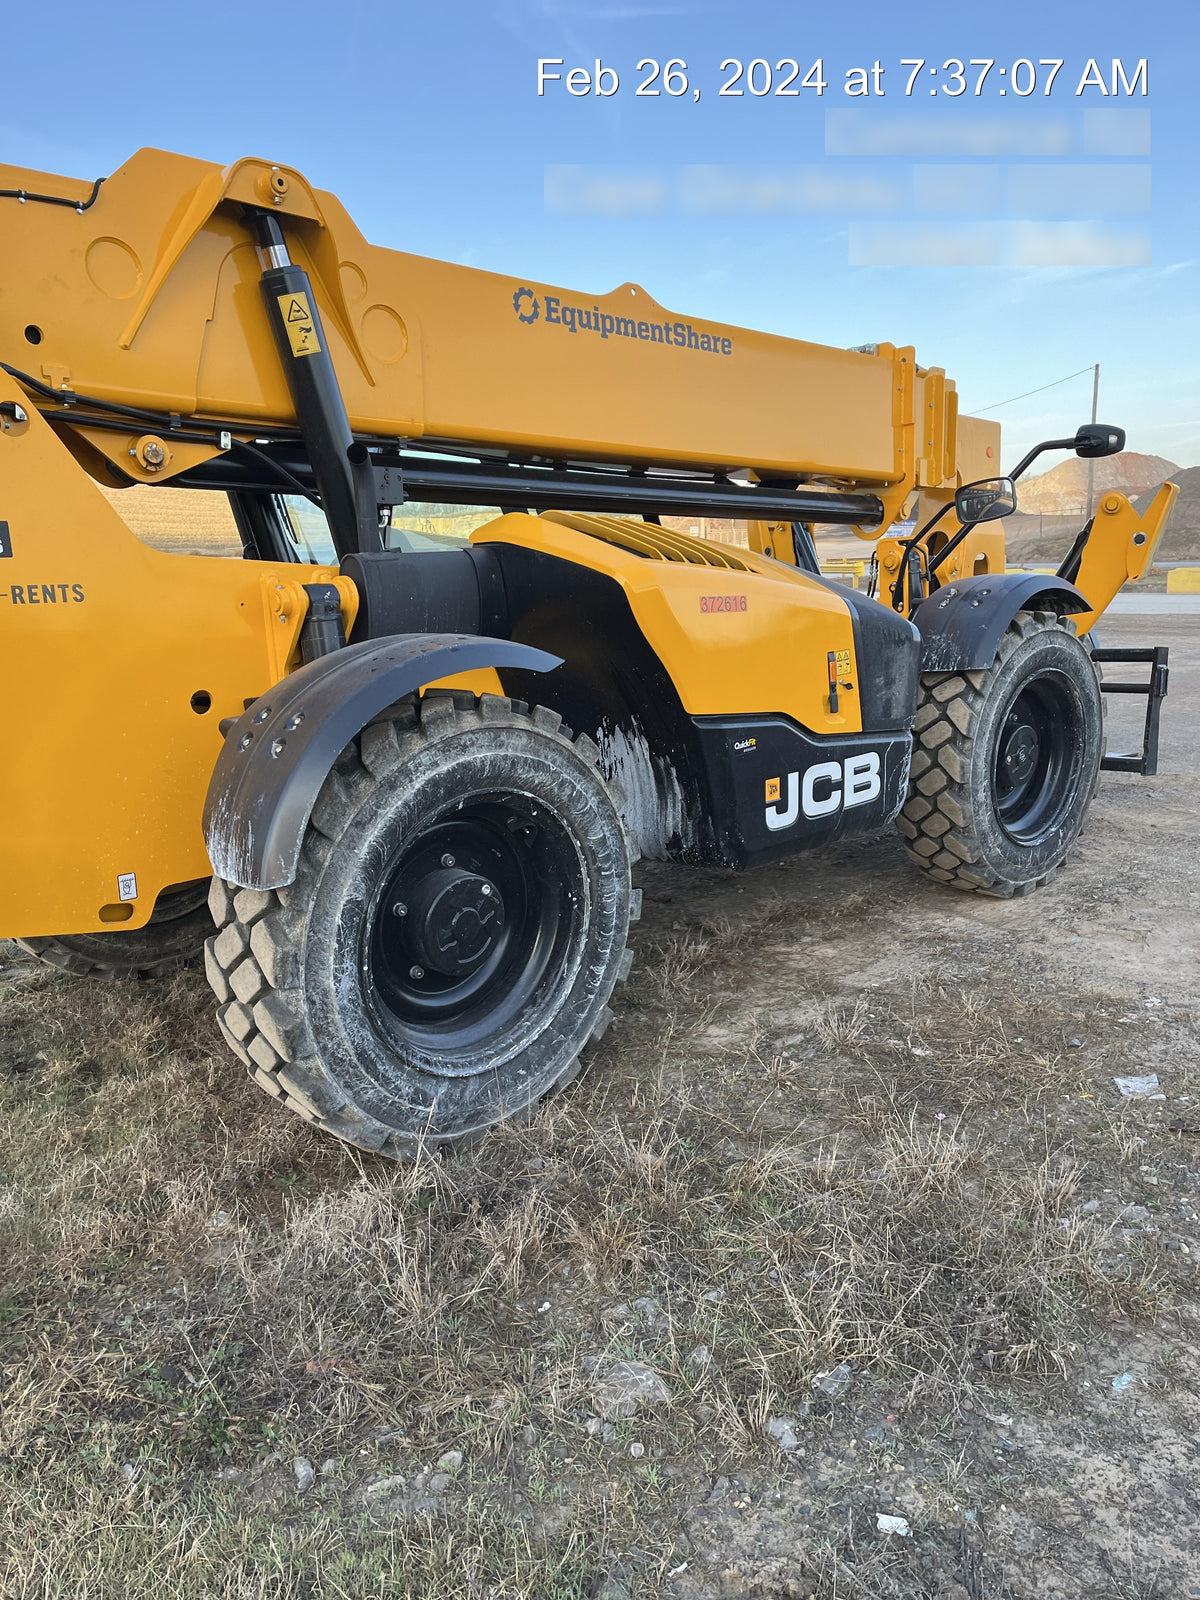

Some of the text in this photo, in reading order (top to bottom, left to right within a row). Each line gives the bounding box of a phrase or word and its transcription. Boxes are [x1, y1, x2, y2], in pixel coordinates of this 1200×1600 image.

[544, 296, 732, 355] EquipmentShare
[700, 595, 747, 613] 372616
[765, 751, 881, 831] JCB
